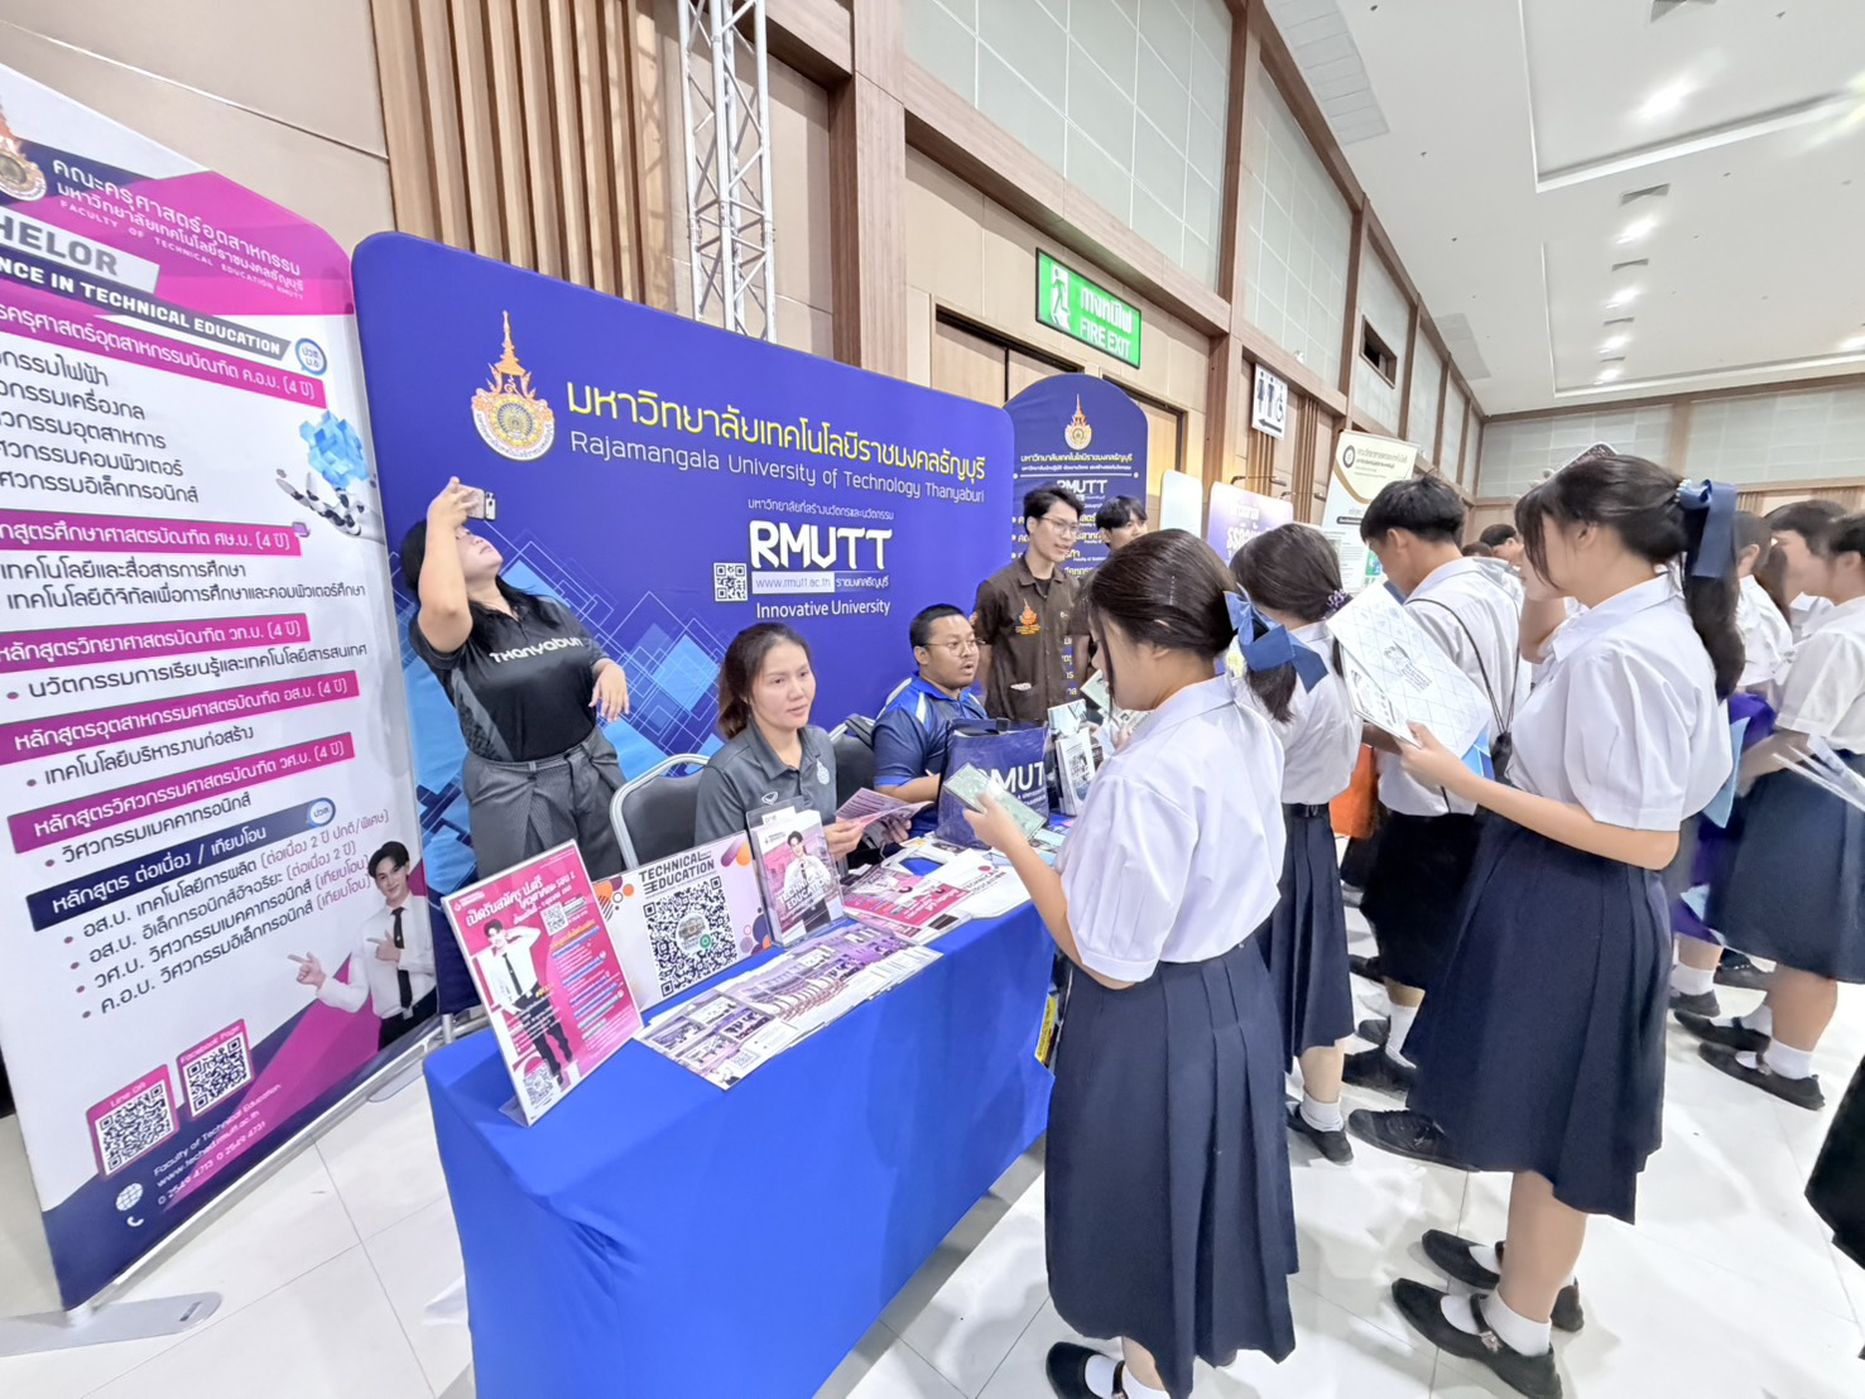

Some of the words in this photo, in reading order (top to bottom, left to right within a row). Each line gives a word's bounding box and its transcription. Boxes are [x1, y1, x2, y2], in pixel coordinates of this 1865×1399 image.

[53, 160, 300, 276] คณะครุศาสตร์อุตสาหกรรม
[60, 200, 118, 228] FACULTY
[129, 227, 144, 238] OF
[154, 237, 213, 267] TECHNICAL
[51, 273, 74, 293] IN
[80, 282, 190, 329] TECHNICAL
[194, 318, 280, 355] EDUCATION
[1081, 317, 1107, 346] FIRE
[1107, 330, 1132, 360] EXIT
[0, 351, 109, 387] กรรมไฟฟ้า
[0, 411, 167, 450] วกรรมอุตสาหการ
[566, 381, 986, 486] มหาวิทยาลัยเทคโนโลยีราชมงคลธัญบุรี
[570, 431, 720, 471] Rajamangala
[728, 454, 816, 488] University
[823, 468, 838, 489] of
[844, 471, 921, 499] Technology
[926, 482, 985, 504] Thanyaburi
[750, 520, 893, 570] RMUTT
[756, 576, 831, 589] www.rmutt.ac.th
[756, 601, 829, 619] Innovative
[831, 598, 891, 617] University
[977, 760, 1045, 794] MUT
[52, 874, 130, 914] หลักสูตร
[134, 851, 192, 884] ต่อเนื่อง
[210, 825, 267, 857] เทียบโอน
[639, 850, 711, 883] TECHNICAL
[643, 858, 715, 893] EDUCATION
[153, 1146, 190, 1177] Faculty
[201, 1110, 242, 1141] Technical
